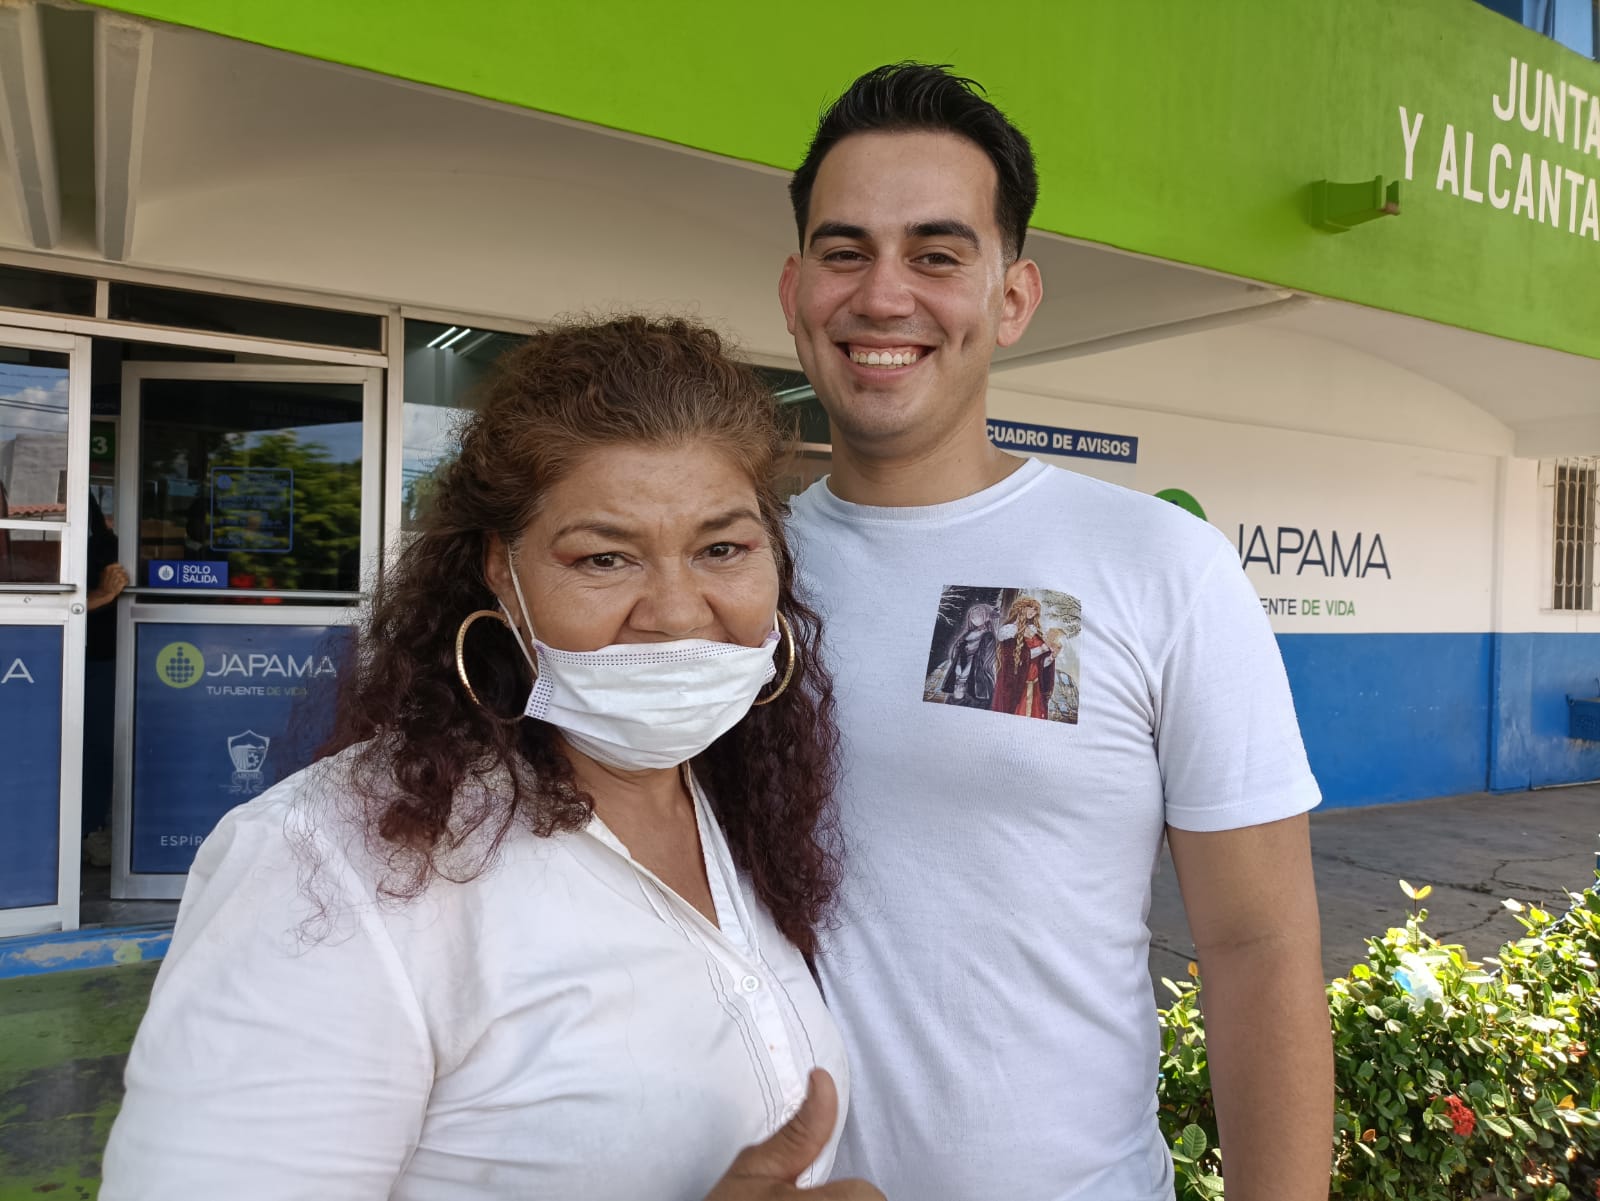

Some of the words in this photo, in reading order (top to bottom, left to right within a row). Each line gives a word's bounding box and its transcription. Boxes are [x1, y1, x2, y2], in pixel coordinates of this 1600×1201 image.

[1492, 56, 1600, 160] JUNTA
[1399, 105, 1424, 181] Y
[1436, 123, 1600, 241] ALCANTA
[92, 436, 108, 455] 3
[986, 424, 1048, 447] CUADRO
[1052, 433, 1073, 450] DE
[1076, 436, 1131, 457] AVISOS
[182, 564, 211, 575] SOLO
[182, 573, 218, 584] SALIDA
[1301, 600, 1321, 616] DE
[1325, 600, 1356, 616] VIDA
[206, 653, 337, 678] JAPAMA
[206, 686, 222, 696] TU
[222, 686, 265, 696] FUENTE
[266, 686, 281, 696] DE
